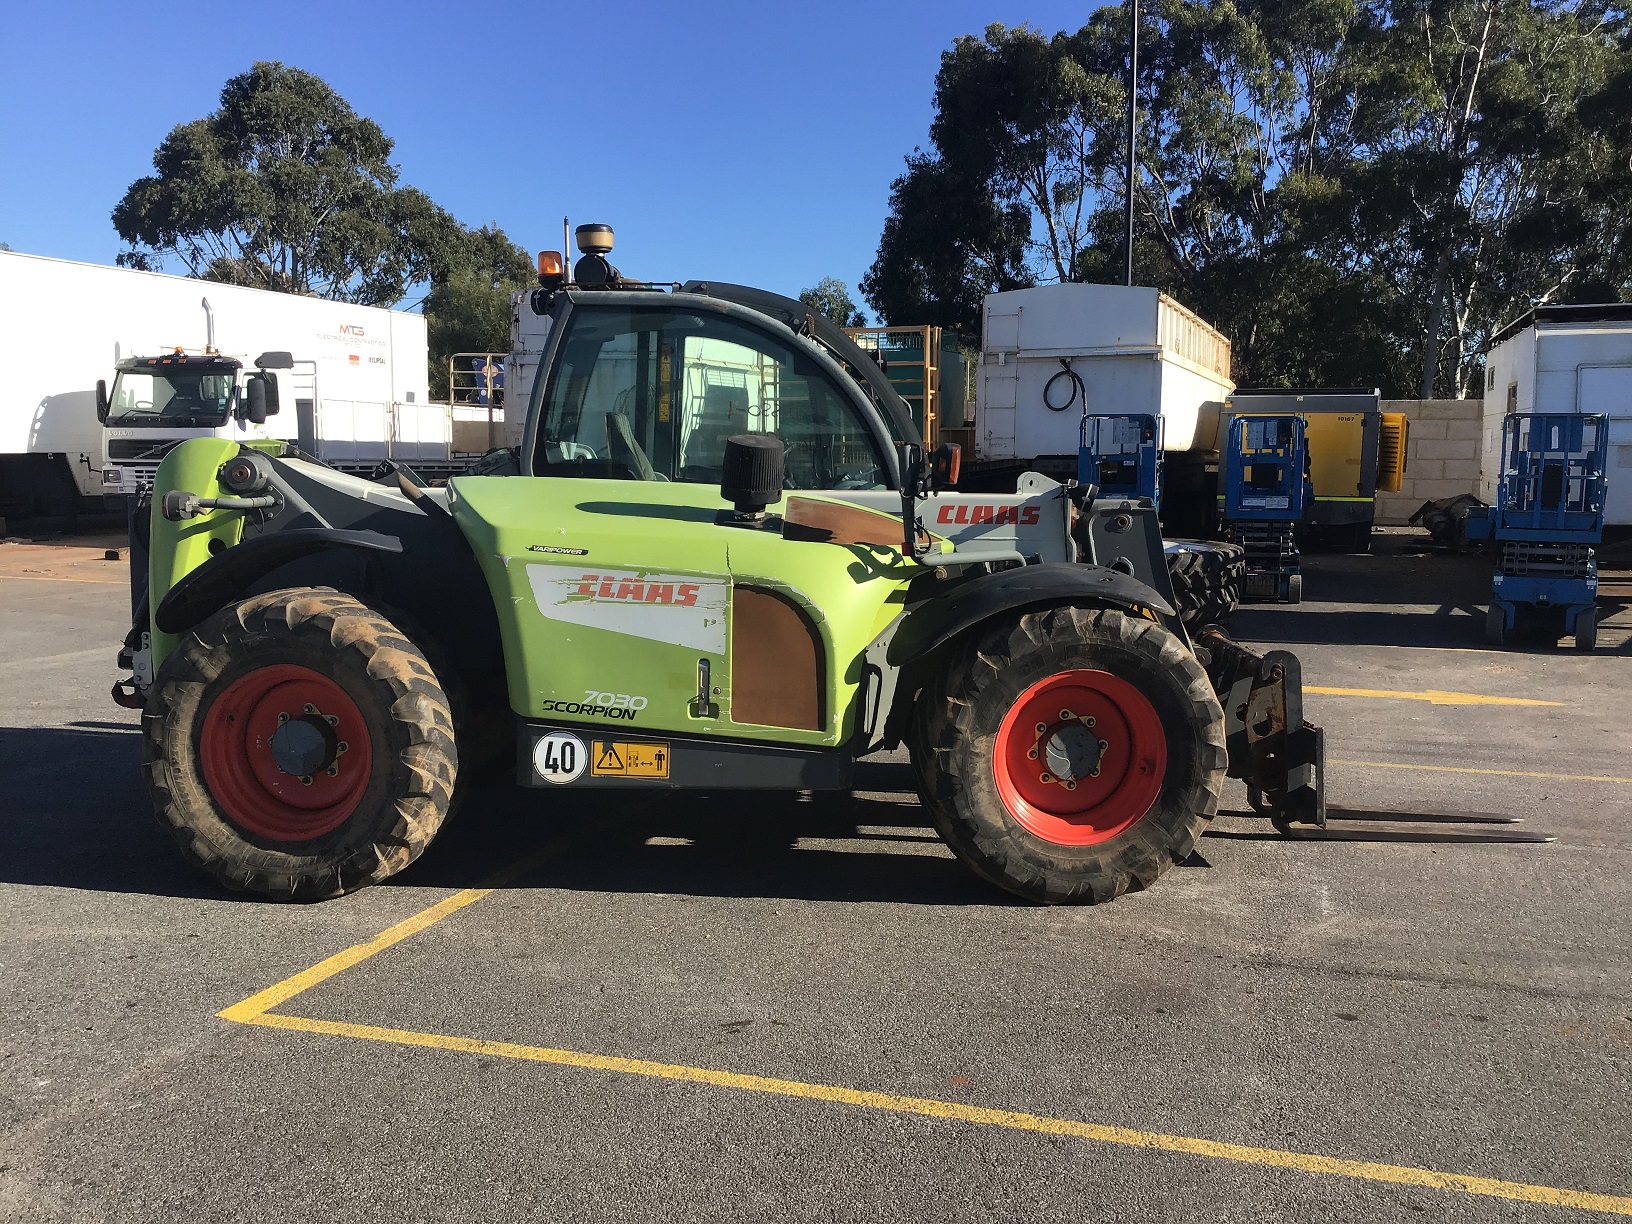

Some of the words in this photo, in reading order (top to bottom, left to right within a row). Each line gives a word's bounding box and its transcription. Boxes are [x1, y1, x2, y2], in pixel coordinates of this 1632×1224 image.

[937, 505, 1041, 524] CLAAS
[532, 545, 583, 555] VARIPOWER
[577, 575, 700, 606] CLAAS
[543, 700, 637, 720] SCORPION
[582, 690, 649, 710] 7030
[545, 741, 576, 774] 40
